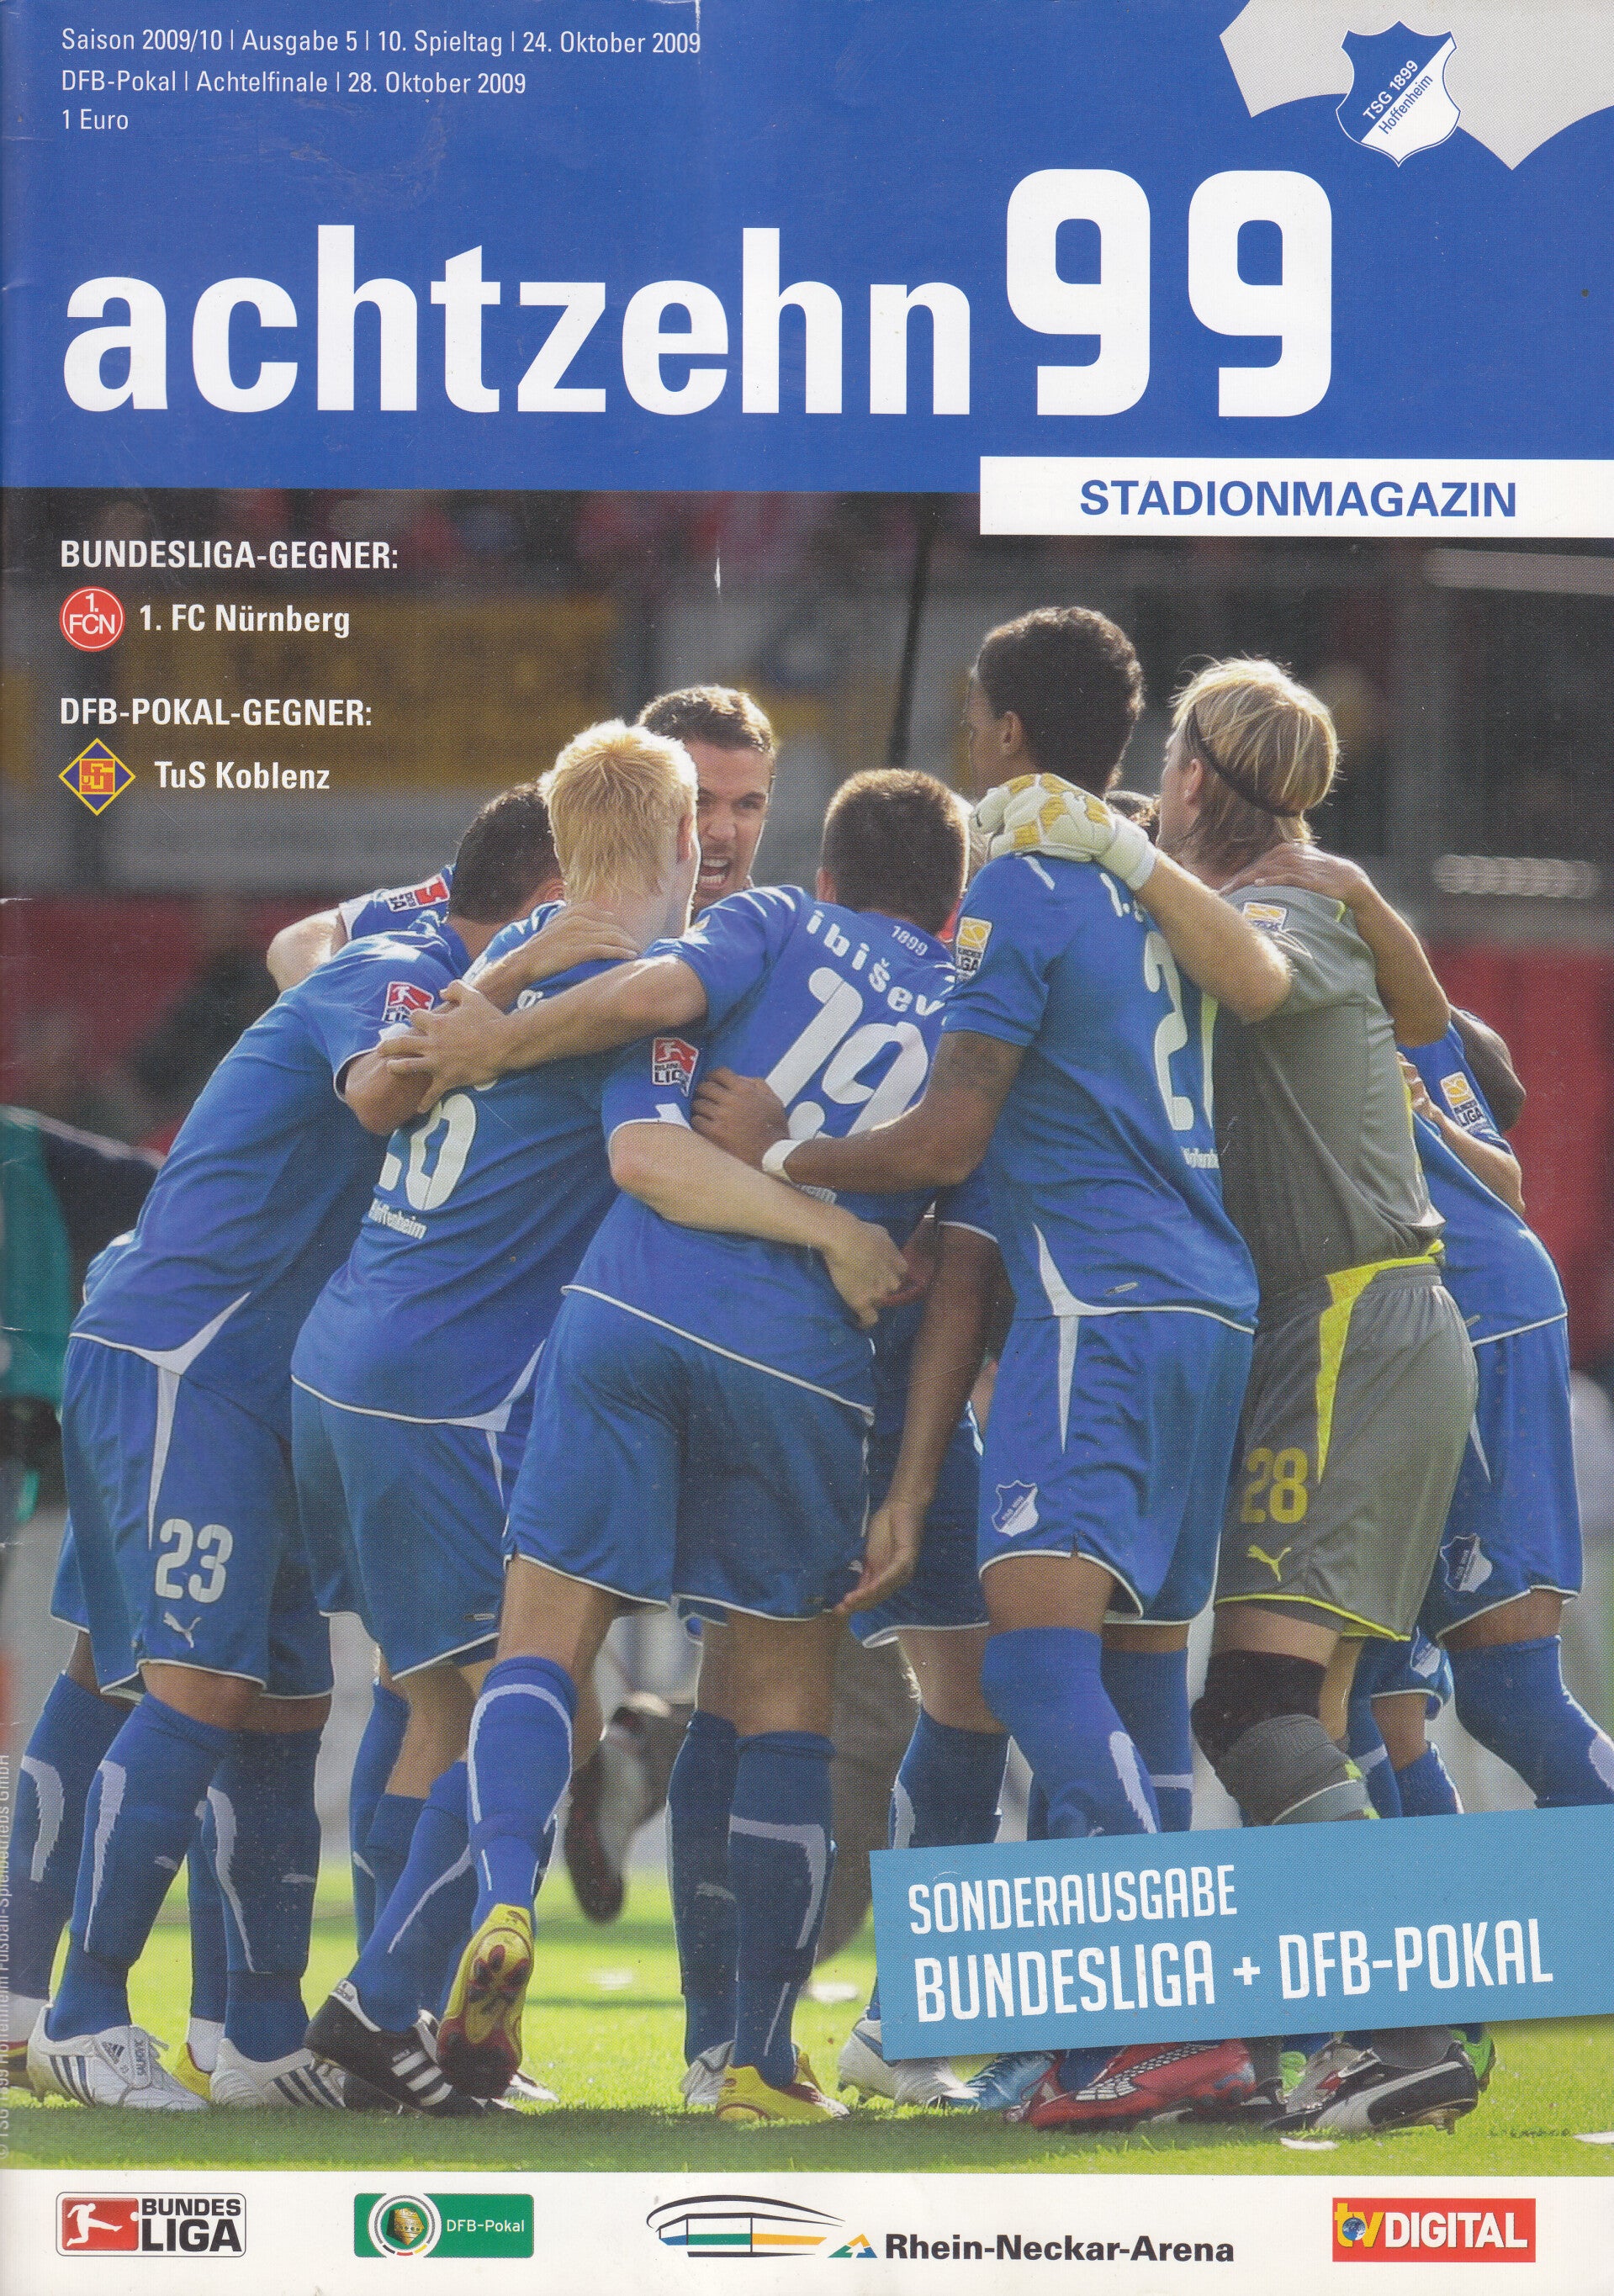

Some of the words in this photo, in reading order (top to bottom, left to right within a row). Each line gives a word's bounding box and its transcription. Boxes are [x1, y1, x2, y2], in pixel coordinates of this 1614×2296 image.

[62, 28, 135, 50] Saison
[142, 29, 223, 53] 2009/10
[241, 29, 338, 56] Ausgabe
[347, 30, 357, 51] 5
[378, 30, 407, 51] 10.
[414, 29, 502, 57] Spieltag
[523, 31, 553, 52] 24.
[560, 30, 646, 53] Oktober
[653, 32, 701, 54] 2009
[62, 70, 176, 92] DFB-Pokal
[196, 70, 327, 93] Achtelfinale
[348, 71, 378, 93] 28.
[386, 71, 471, 93] Oktober
[478, 72, 526, 94] 2009
[1363, 91, 1393, 120] TSG
[1389, 60, 1419, 92] 1899
[62, 109, 70, 130] 1
[81, 108, 129, 130] Euro
[1378, 74, 1433, 135] Hoffenheim
[1080, 479, 1516, 517] STADIONMAGAZIN
[61, 540, 398, 569] BUNDESLIGA-GEGNER:
[85, 592, 99, 612] 1.
[69, 613, 116, 635] FCN
[140, 605, 161, 631] 1.
[172, 604, 205, 632] FC
[215, 604, 350, 638] Nürnberg
[61, 697, 372, 726] DFB-POKAL-GEGNER:
[154, 760, 206, 789] TuS
[216, 761, 331, 790] Koblenz
[892, 925, 929, 956] 1899
[807, 910, 948, 1026] ibišev
[765, 966, 929, 1139] 19
[1240, 1447, 1309, 1524] 28
[154, 1517, 234, 1604] 23
[908, 1864, 1238, 1935] SONDERAUSGABE
[914, 1939, 1215, 2023] BUNDESLIGA
[1278, 1918, 1554, 2000] DFB-POKAL
[141, 2198, 241, 2216] BUNDES
[141, 2219, 242, 2252] LIGA
[446, 2219, 525, 2233] DFB-Pokal
[886, 2234, 1234, 2262] Rhein-Neckar-Arena
